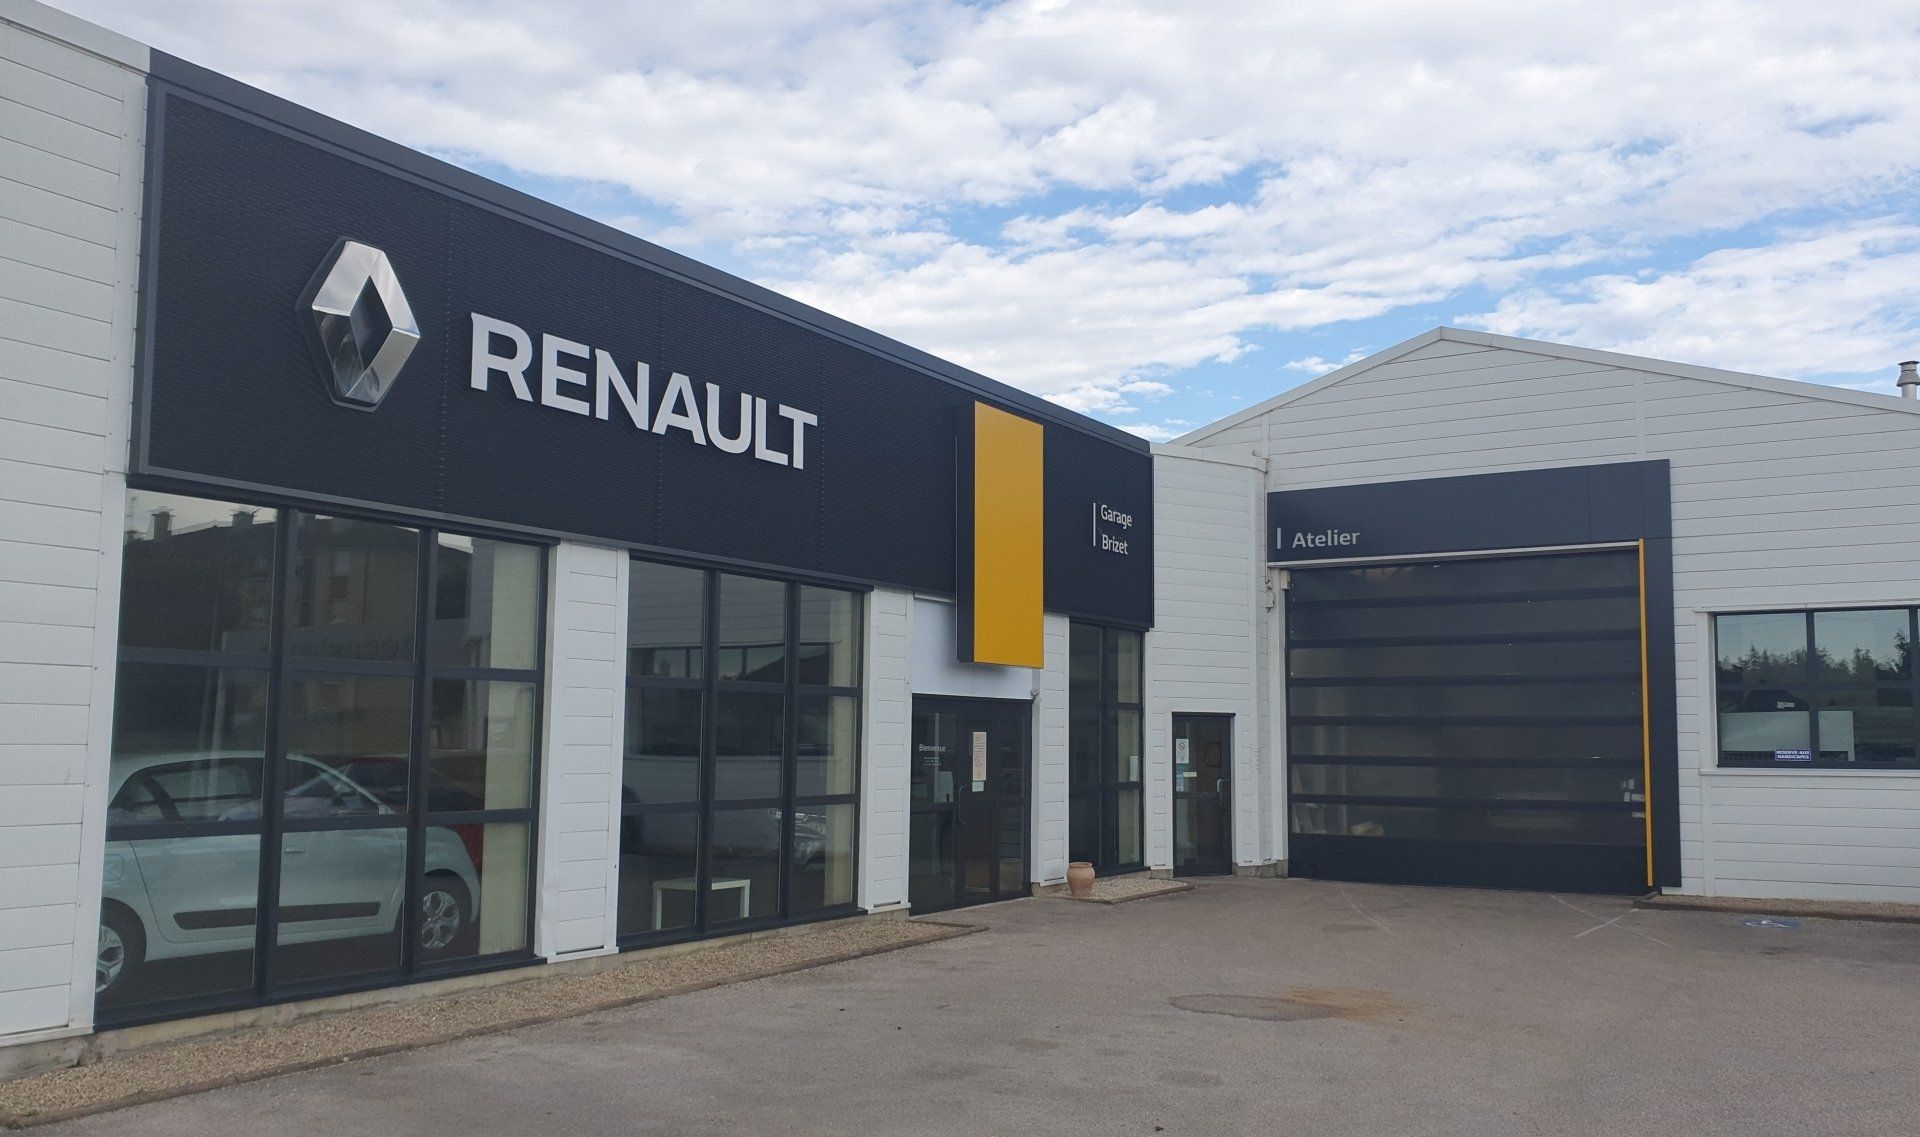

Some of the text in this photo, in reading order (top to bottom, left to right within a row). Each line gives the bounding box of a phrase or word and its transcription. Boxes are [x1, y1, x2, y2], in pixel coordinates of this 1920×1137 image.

[470, 312, 818, 470] RENAULT
[1100, 504, 1133, 530] Garage
[1102, 534, 1129, 556] Brizet
[1291, 528, 1361, 549] Atelier
[918, 743, 947, 753] Bienvenue
